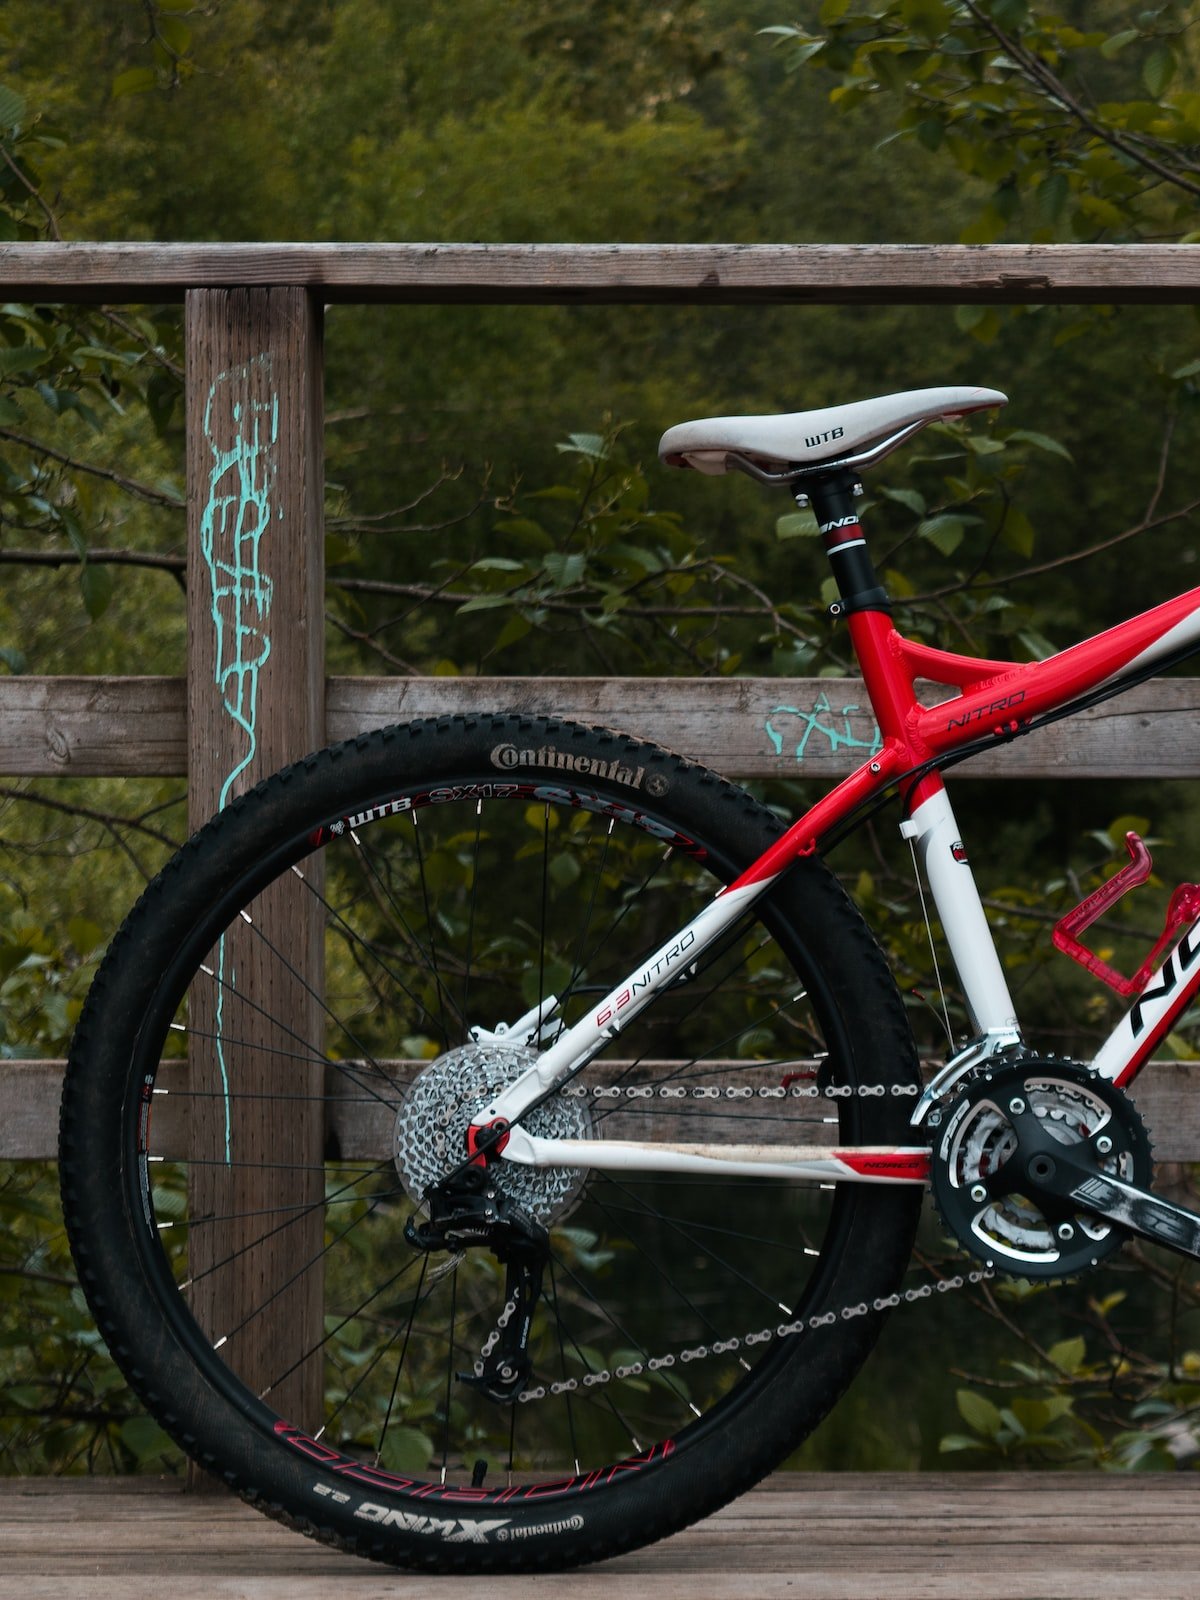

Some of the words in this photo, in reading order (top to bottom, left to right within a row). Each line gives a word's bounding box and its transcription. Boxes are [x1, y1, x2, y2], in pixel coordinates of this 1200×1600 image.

[804, 426, 844, 448] WTB
[946, 690, 1026, 732] NITRO
[490, 742, 646, 790] Continental
[347, 797, 412, 829] WTB
[429, 784, 519, 804] SX17
[596, 989, 631, 1027] 6.3
[632, 930, 695, 996] NITRO
[864, 1161, 920, 1169] NORCO
